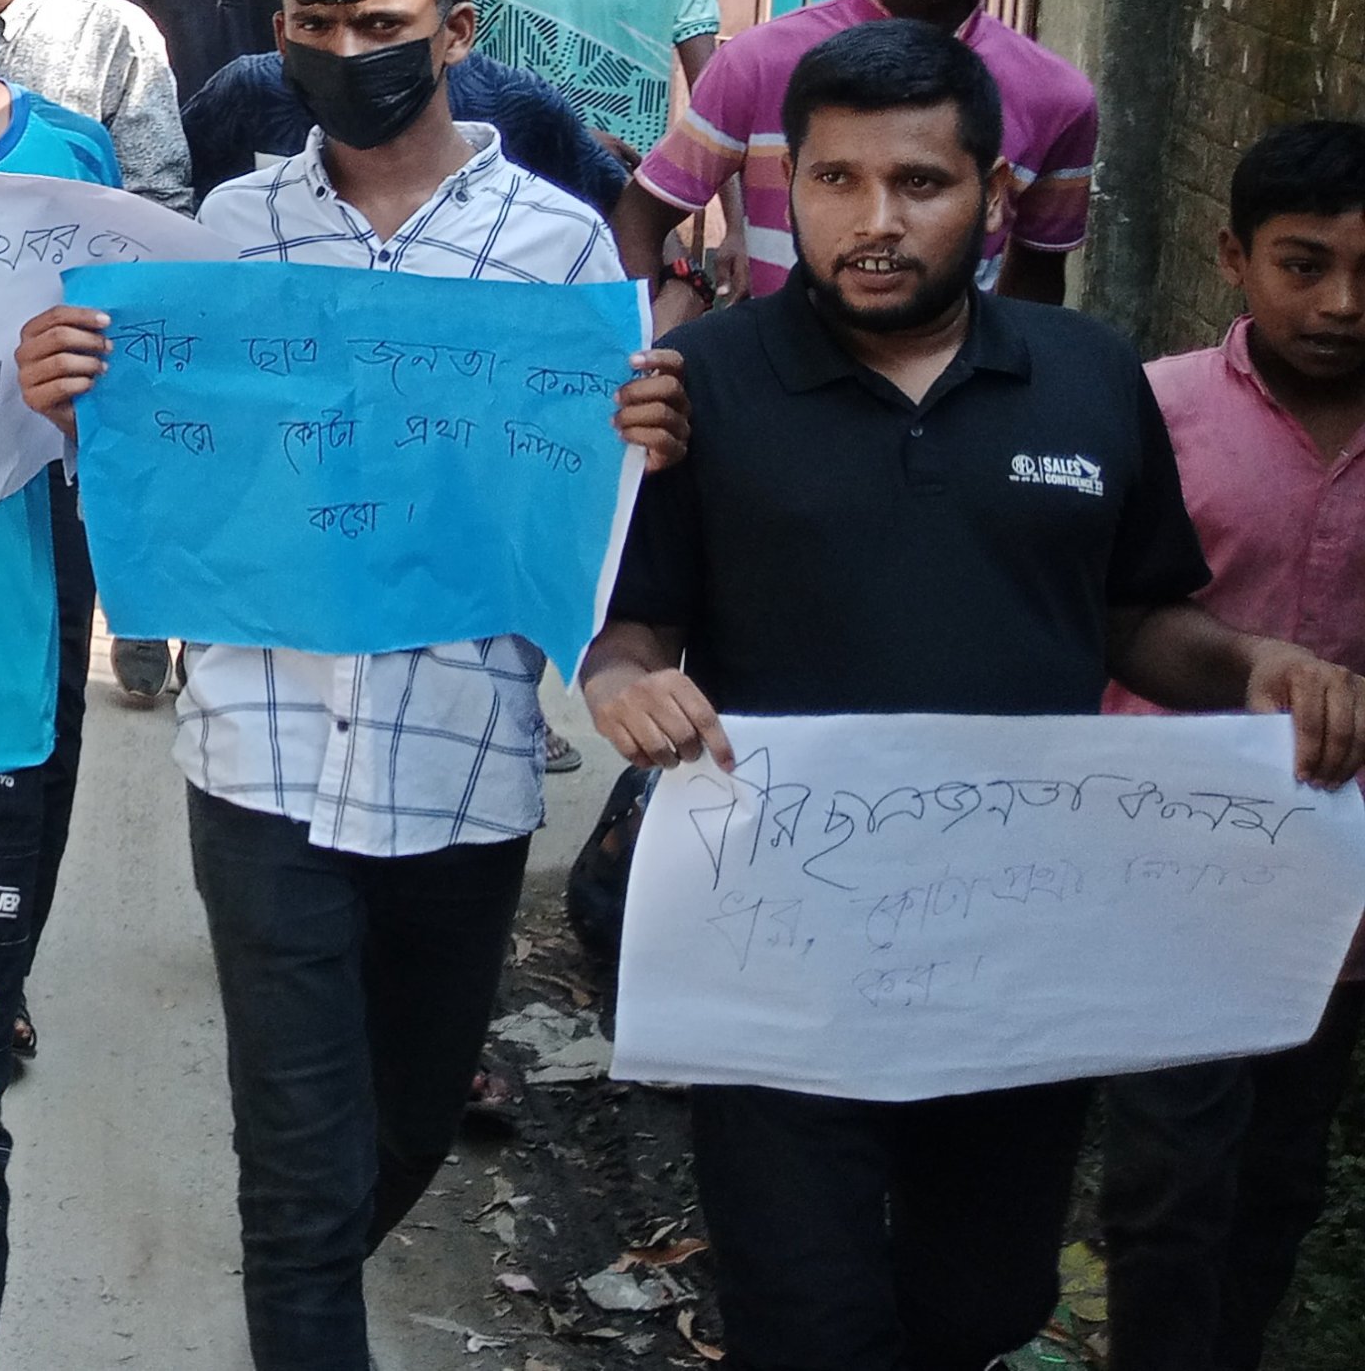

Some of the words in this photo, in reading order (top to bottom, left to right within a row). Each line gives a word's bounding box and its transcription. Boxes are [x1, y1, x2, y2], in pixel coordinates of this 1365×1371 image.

[109, 319, 202, 373] বীর
[278, 409, 364, 476] কোটা
[1043, 456, 1083, 477] SALES
